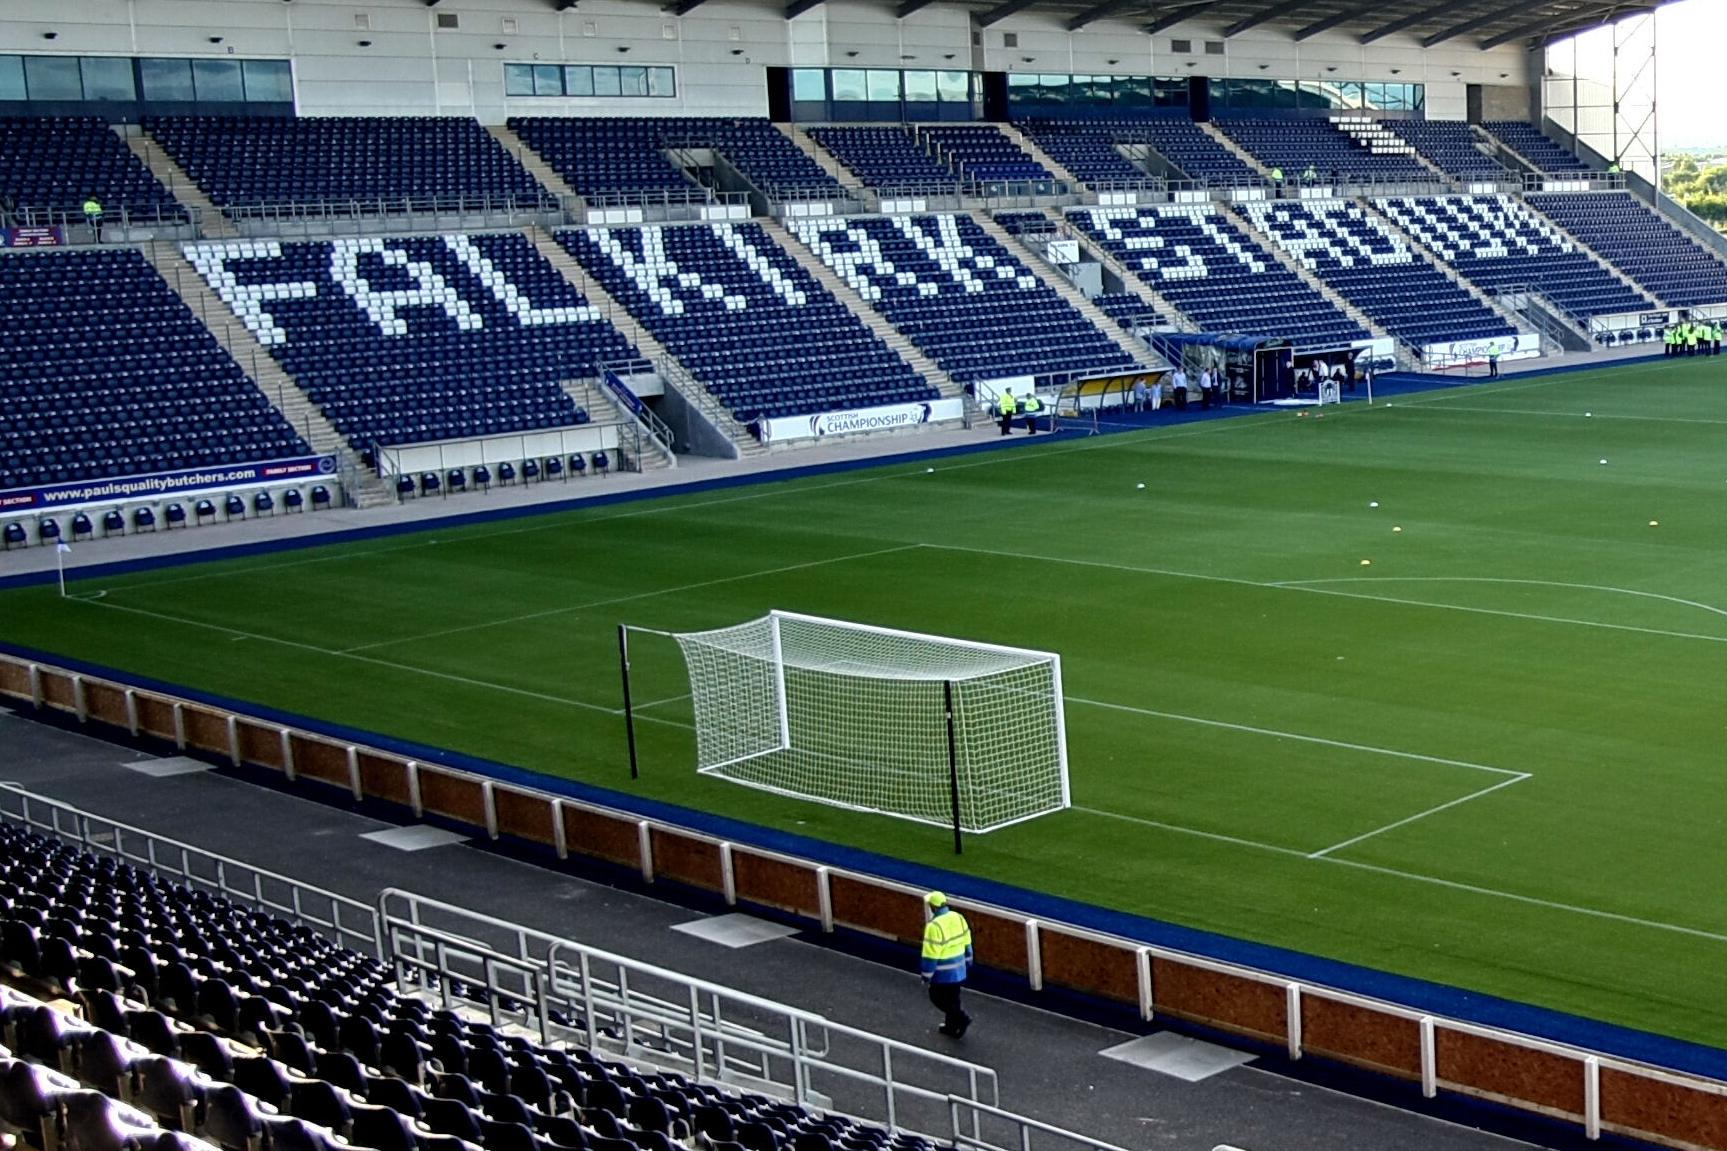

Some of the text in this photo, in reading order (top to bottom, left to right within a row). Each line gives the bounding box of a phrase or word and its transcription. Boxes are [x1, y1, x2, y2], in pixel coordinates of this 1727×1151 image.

[826, 413, 859, 421] SCOTTISH
[827, 413, 909, 433] CHAMPIONSHIP
[44, 468, 256, 501] www.paulsqualitybutchers.com
